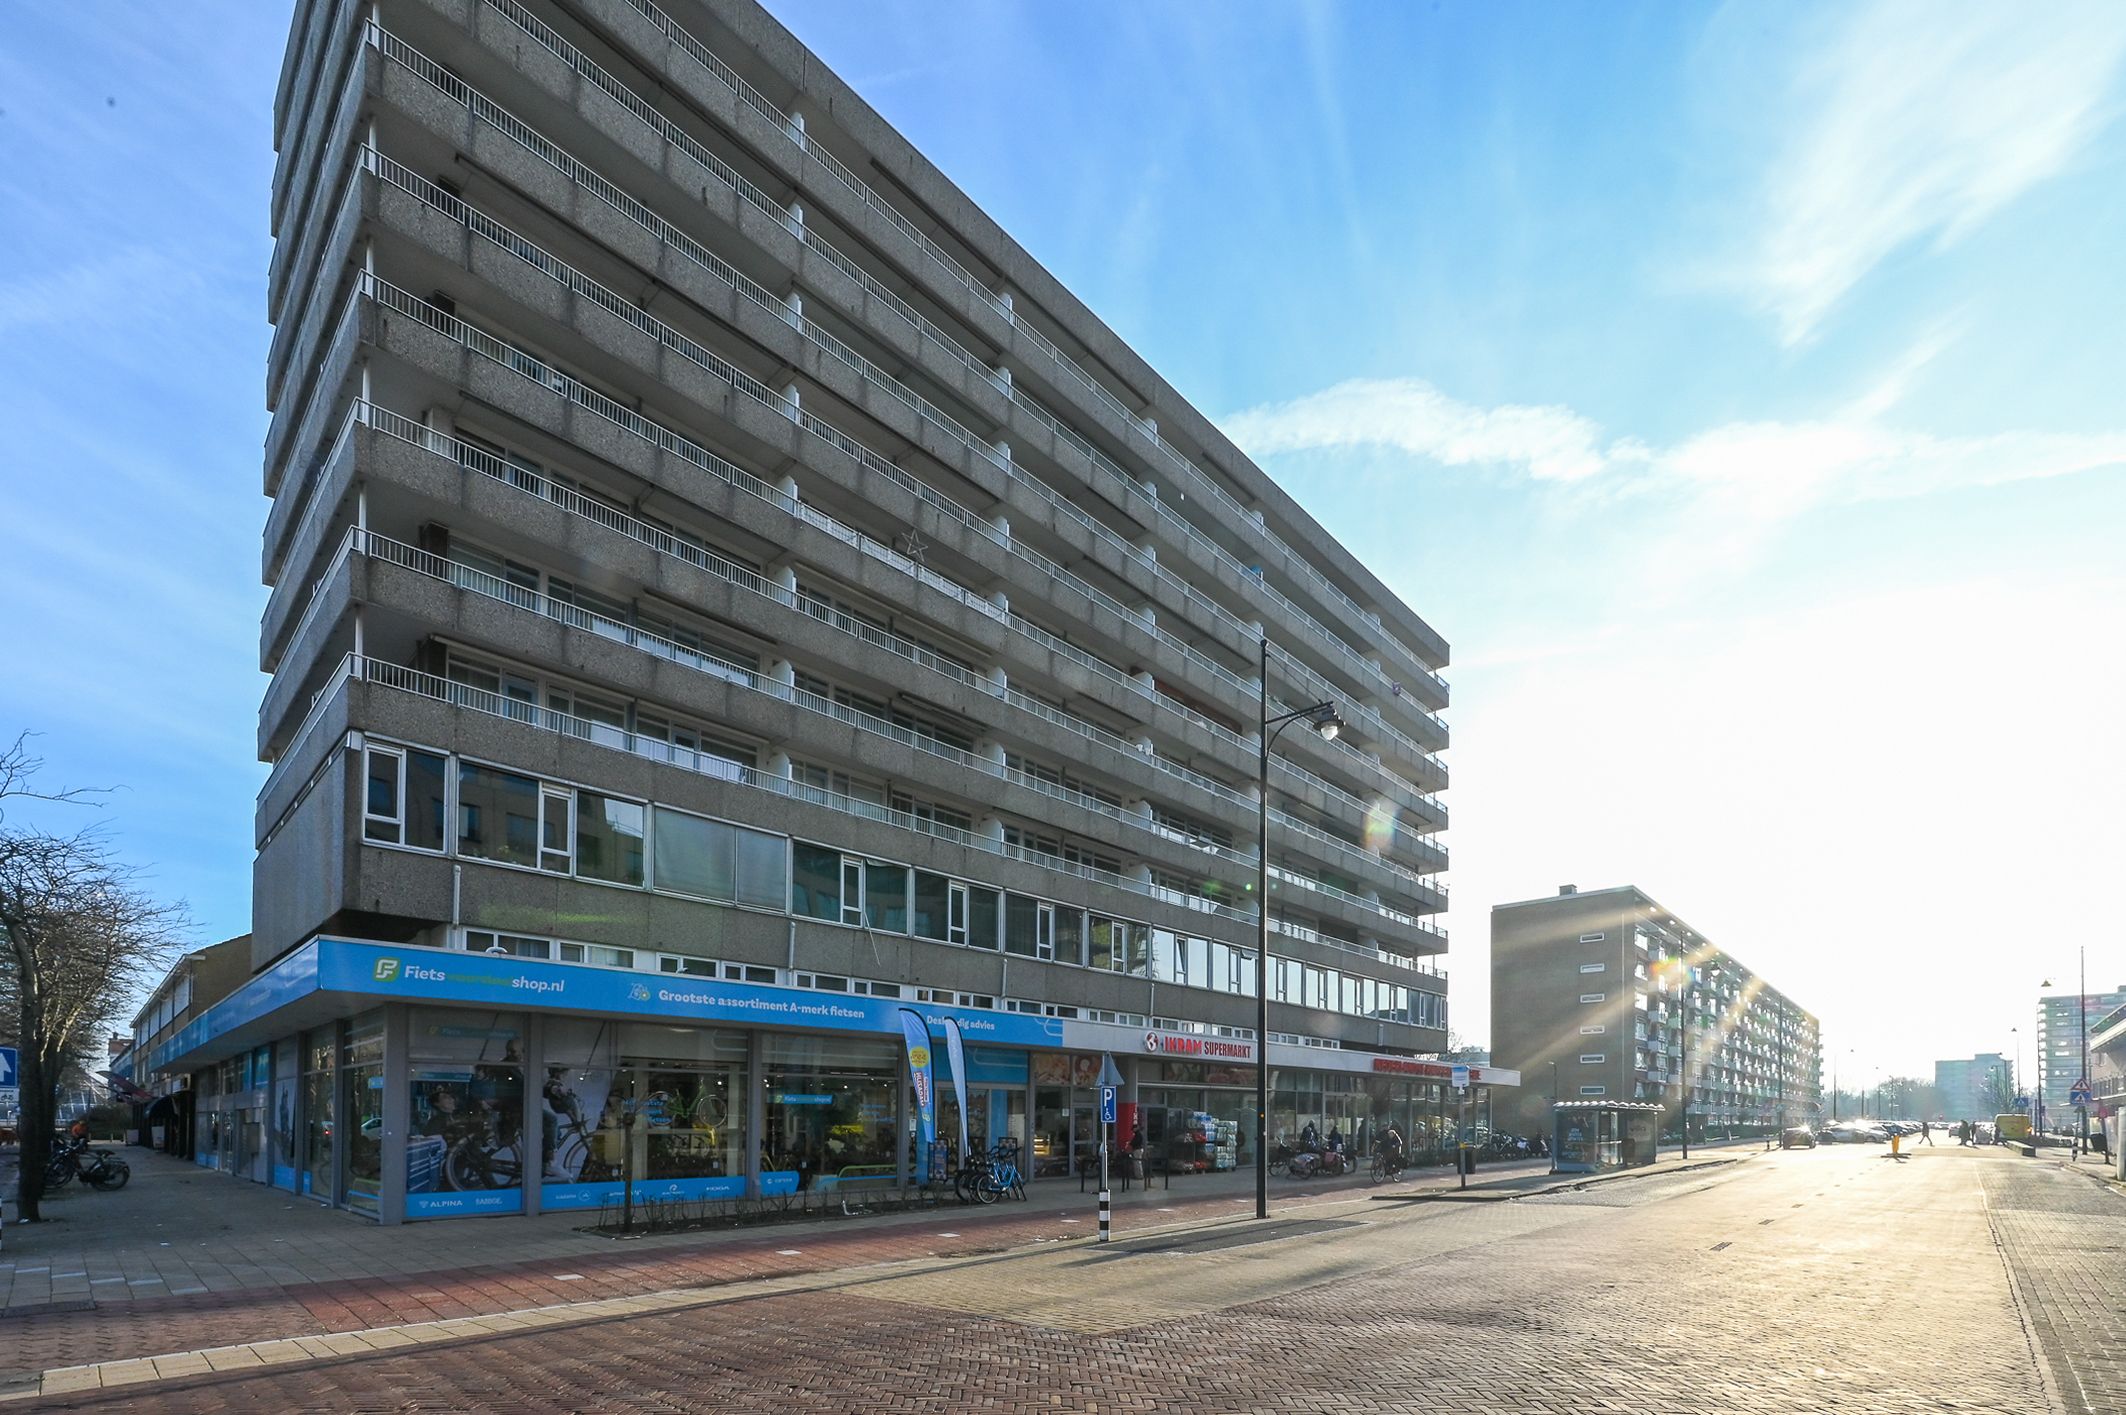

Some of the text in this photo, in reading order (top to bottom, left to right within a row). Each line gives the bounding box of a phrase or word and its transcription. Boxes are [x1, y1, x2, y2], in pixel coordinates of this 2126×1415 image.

[658, 989, 865, 1019] Grootste assortiment A-merk fietsen
[927, 1015, 995, 1031] Deskdig advies
[1165, 1036, 1251, 1058] IKRAM SUPERMARKT
[1104, 1088, 1112, 1107] P
